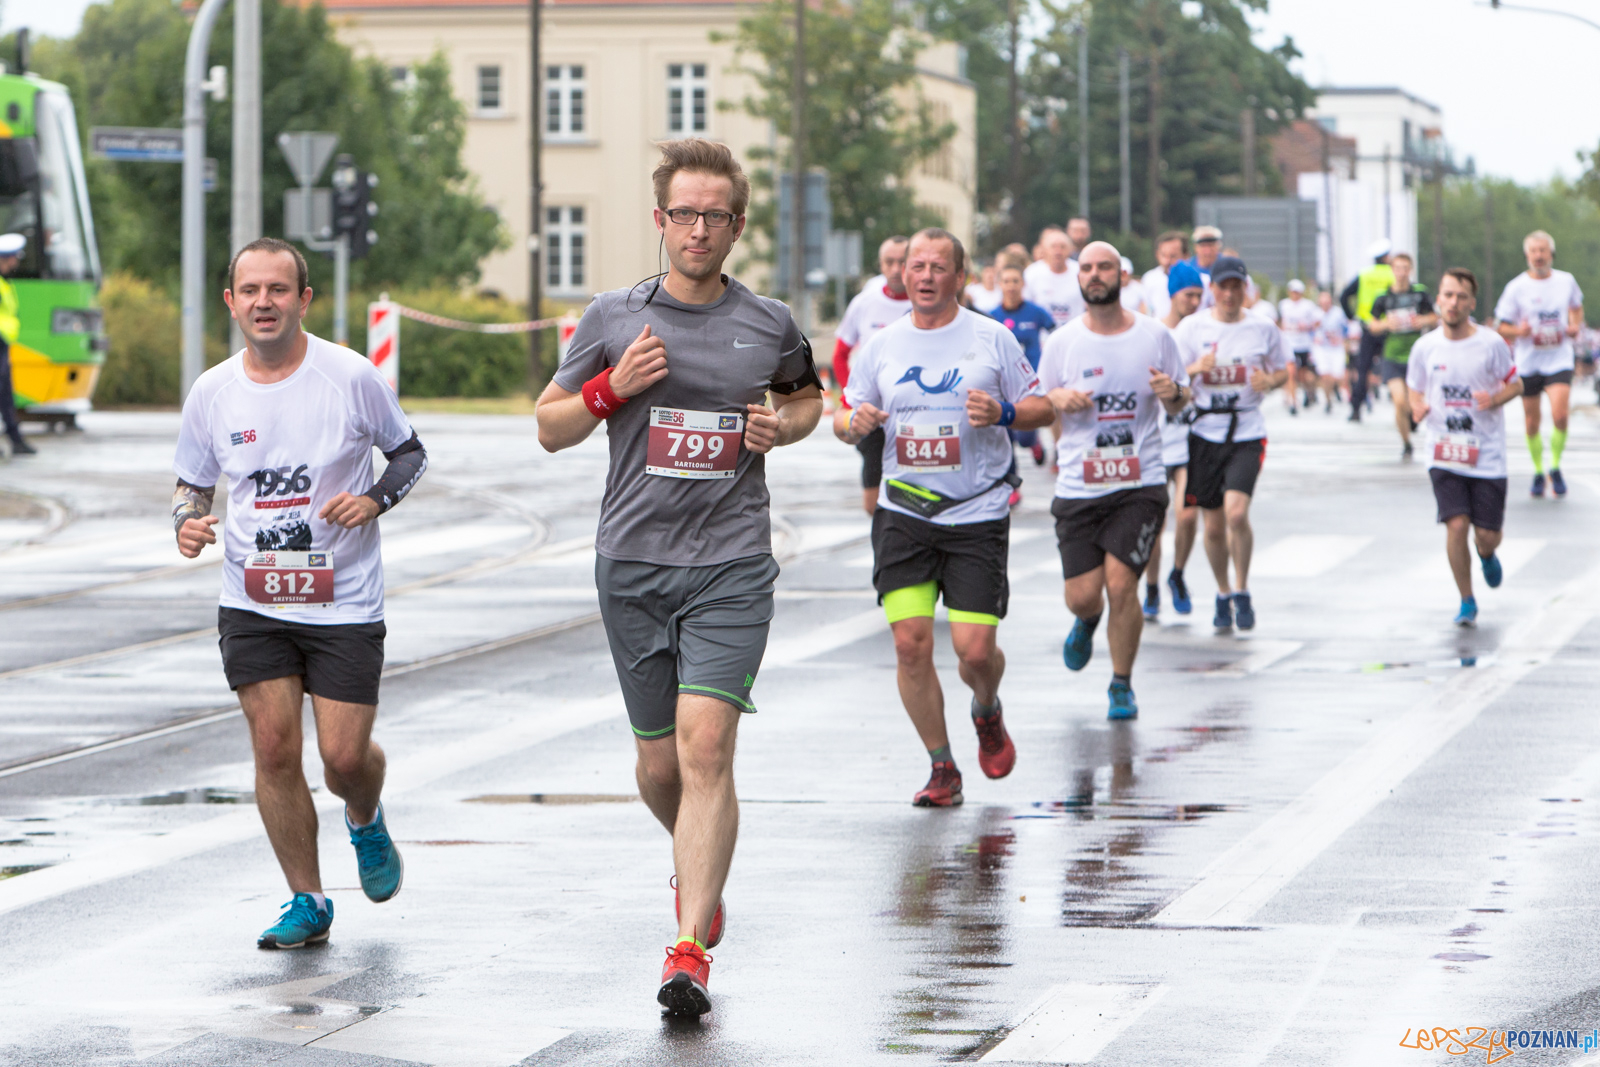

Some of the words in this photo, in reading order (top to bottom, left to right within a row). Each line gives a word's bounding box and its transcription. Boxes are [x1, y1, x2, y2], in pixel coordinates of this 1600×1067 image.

[1092, 391, 1137, 412] 1956
[667, 432, 725, 460] 799
[906, 440, 947, 459] 844
[674, 460, 714, 470] BARTŁOMIEJ
[1093, 459, 1130, 479] 306
[247, 463, 311, 497] 1956
[264, 572, 315, 594] 812
